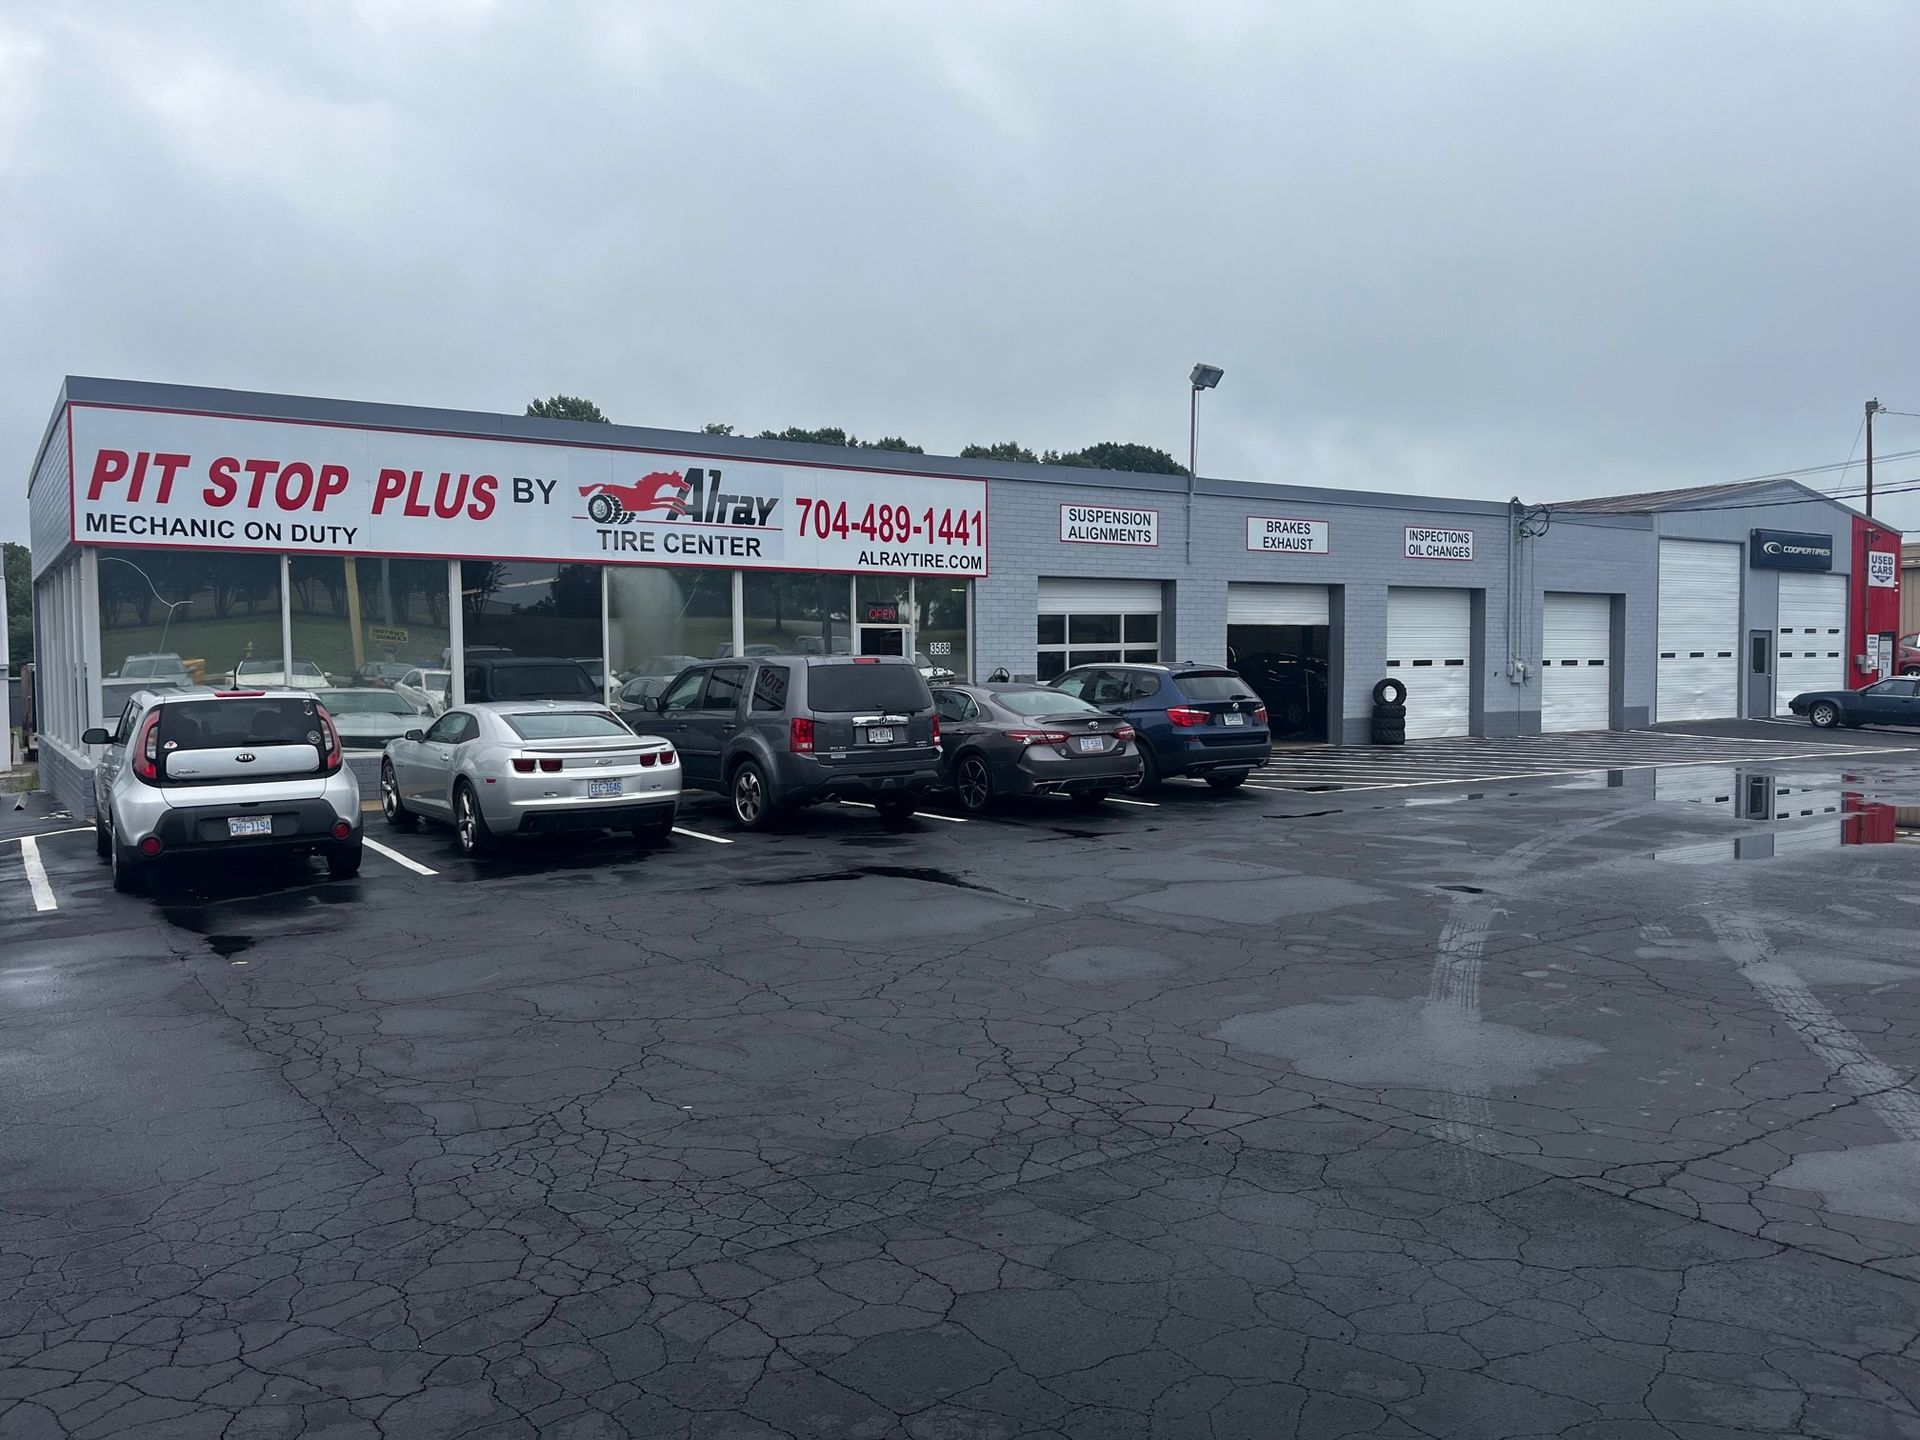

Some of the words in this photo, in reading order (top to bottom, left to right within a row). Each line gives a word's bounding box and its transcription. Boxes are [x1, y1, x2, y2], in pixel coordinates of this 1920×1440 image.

[86, 449, 191, 504] PIT
[202, 456, 349, 512] STOP
[371, 468, 498, 521] PLUS
[512, 477, 557, 505] BY
[666, 467, 780, 527] Alray
[795, 496, 983, 548] 704-489-1441
[1068, 507, 1152, 527] SUSPENSION
[85, 513, 236, 540] MECHANIC
[243, 521, 282, 541] ON
[290, 524, 359, 545] DUTY
[1068, 526, 1152, 544] ALIGNMENTS
[1266, 520, 1312, 536] BRAKES
[596, 529, 656, 553] TIRE
[663, 533, 762, 558] CENTER
[1262, 536, 1314, 551] EXHAUST
[1408, 529, 1471, 545] INSPECTIONS
[1408, 544, 1424, 557] OIL
[1426, 545, 1471, 559] CHANGES
[1871, 554, 1893, 566] USED
[857, 550, 983, 571] ALRAYTIRE.COM
[1871, 564, 1893, 575] CARS
[868, 608, 897, 620] OPEN
[930, 643, 950, 654] 3588
